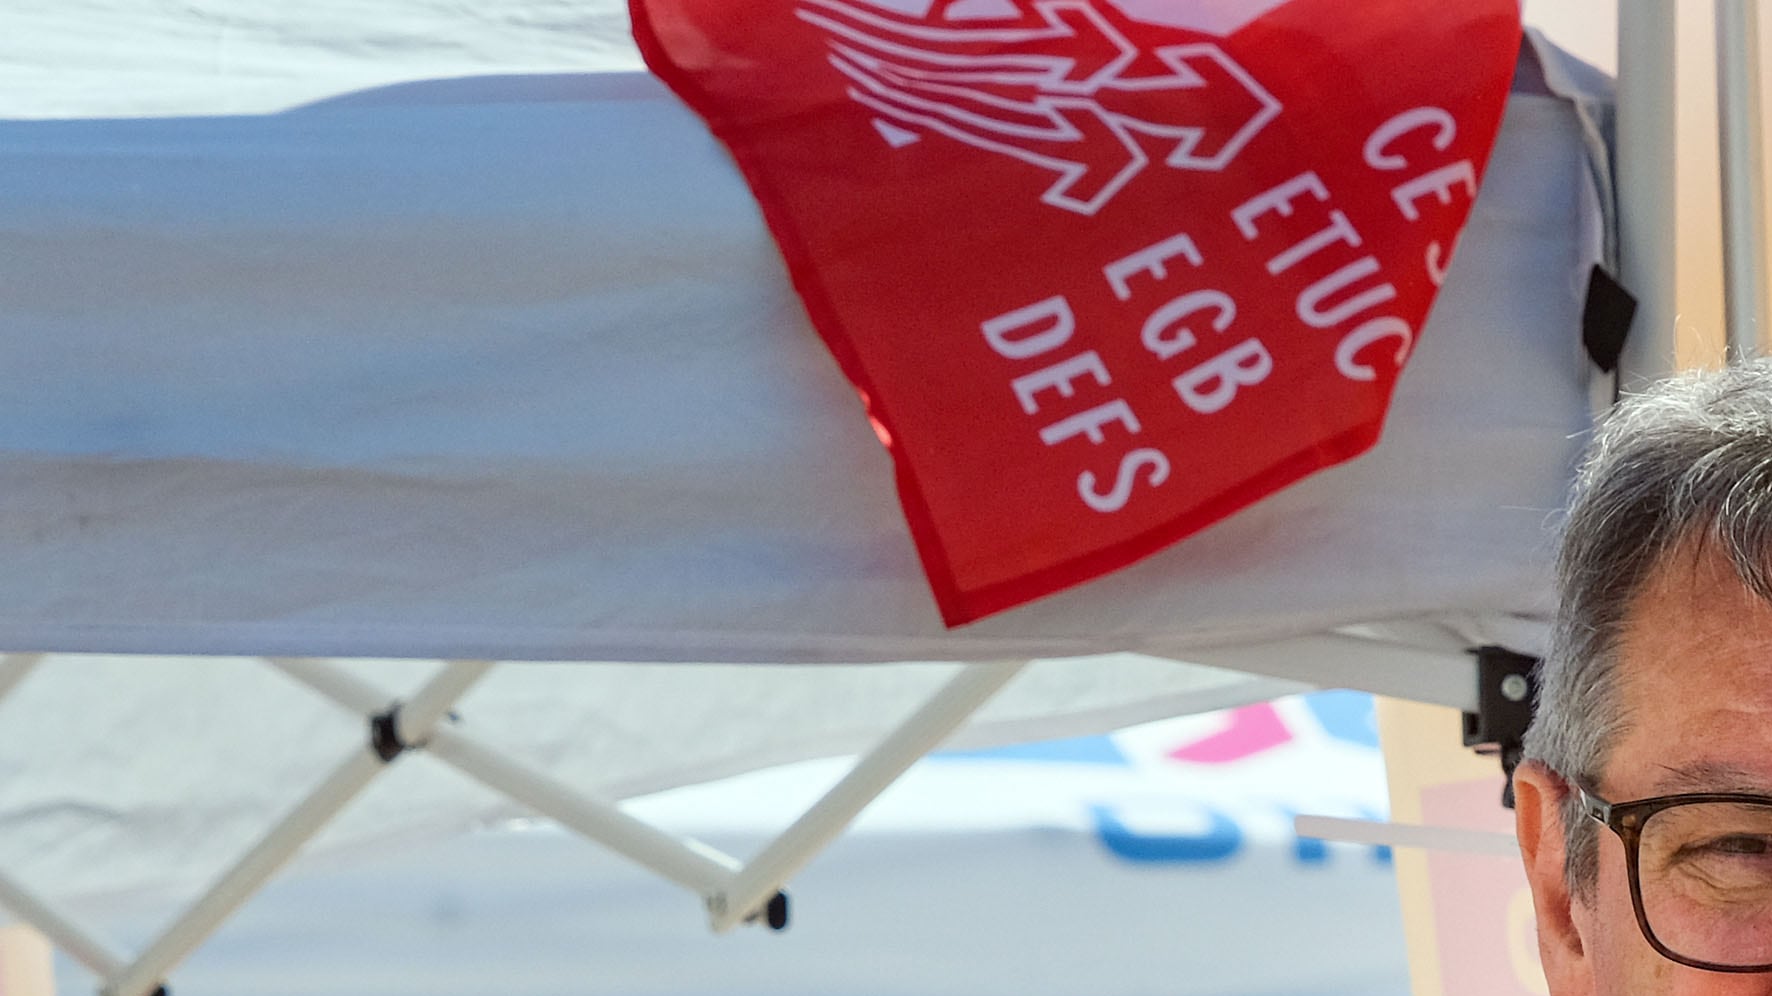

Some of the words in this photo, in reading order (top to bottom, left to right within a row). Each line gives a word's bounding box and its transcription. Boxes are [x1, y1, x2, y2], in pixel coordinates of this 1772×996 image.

[1102, 232, 1274, 415] EGB
[1229, 171, 1414, 382] ETUC
[980, 295, 1171, 514] DEFS
